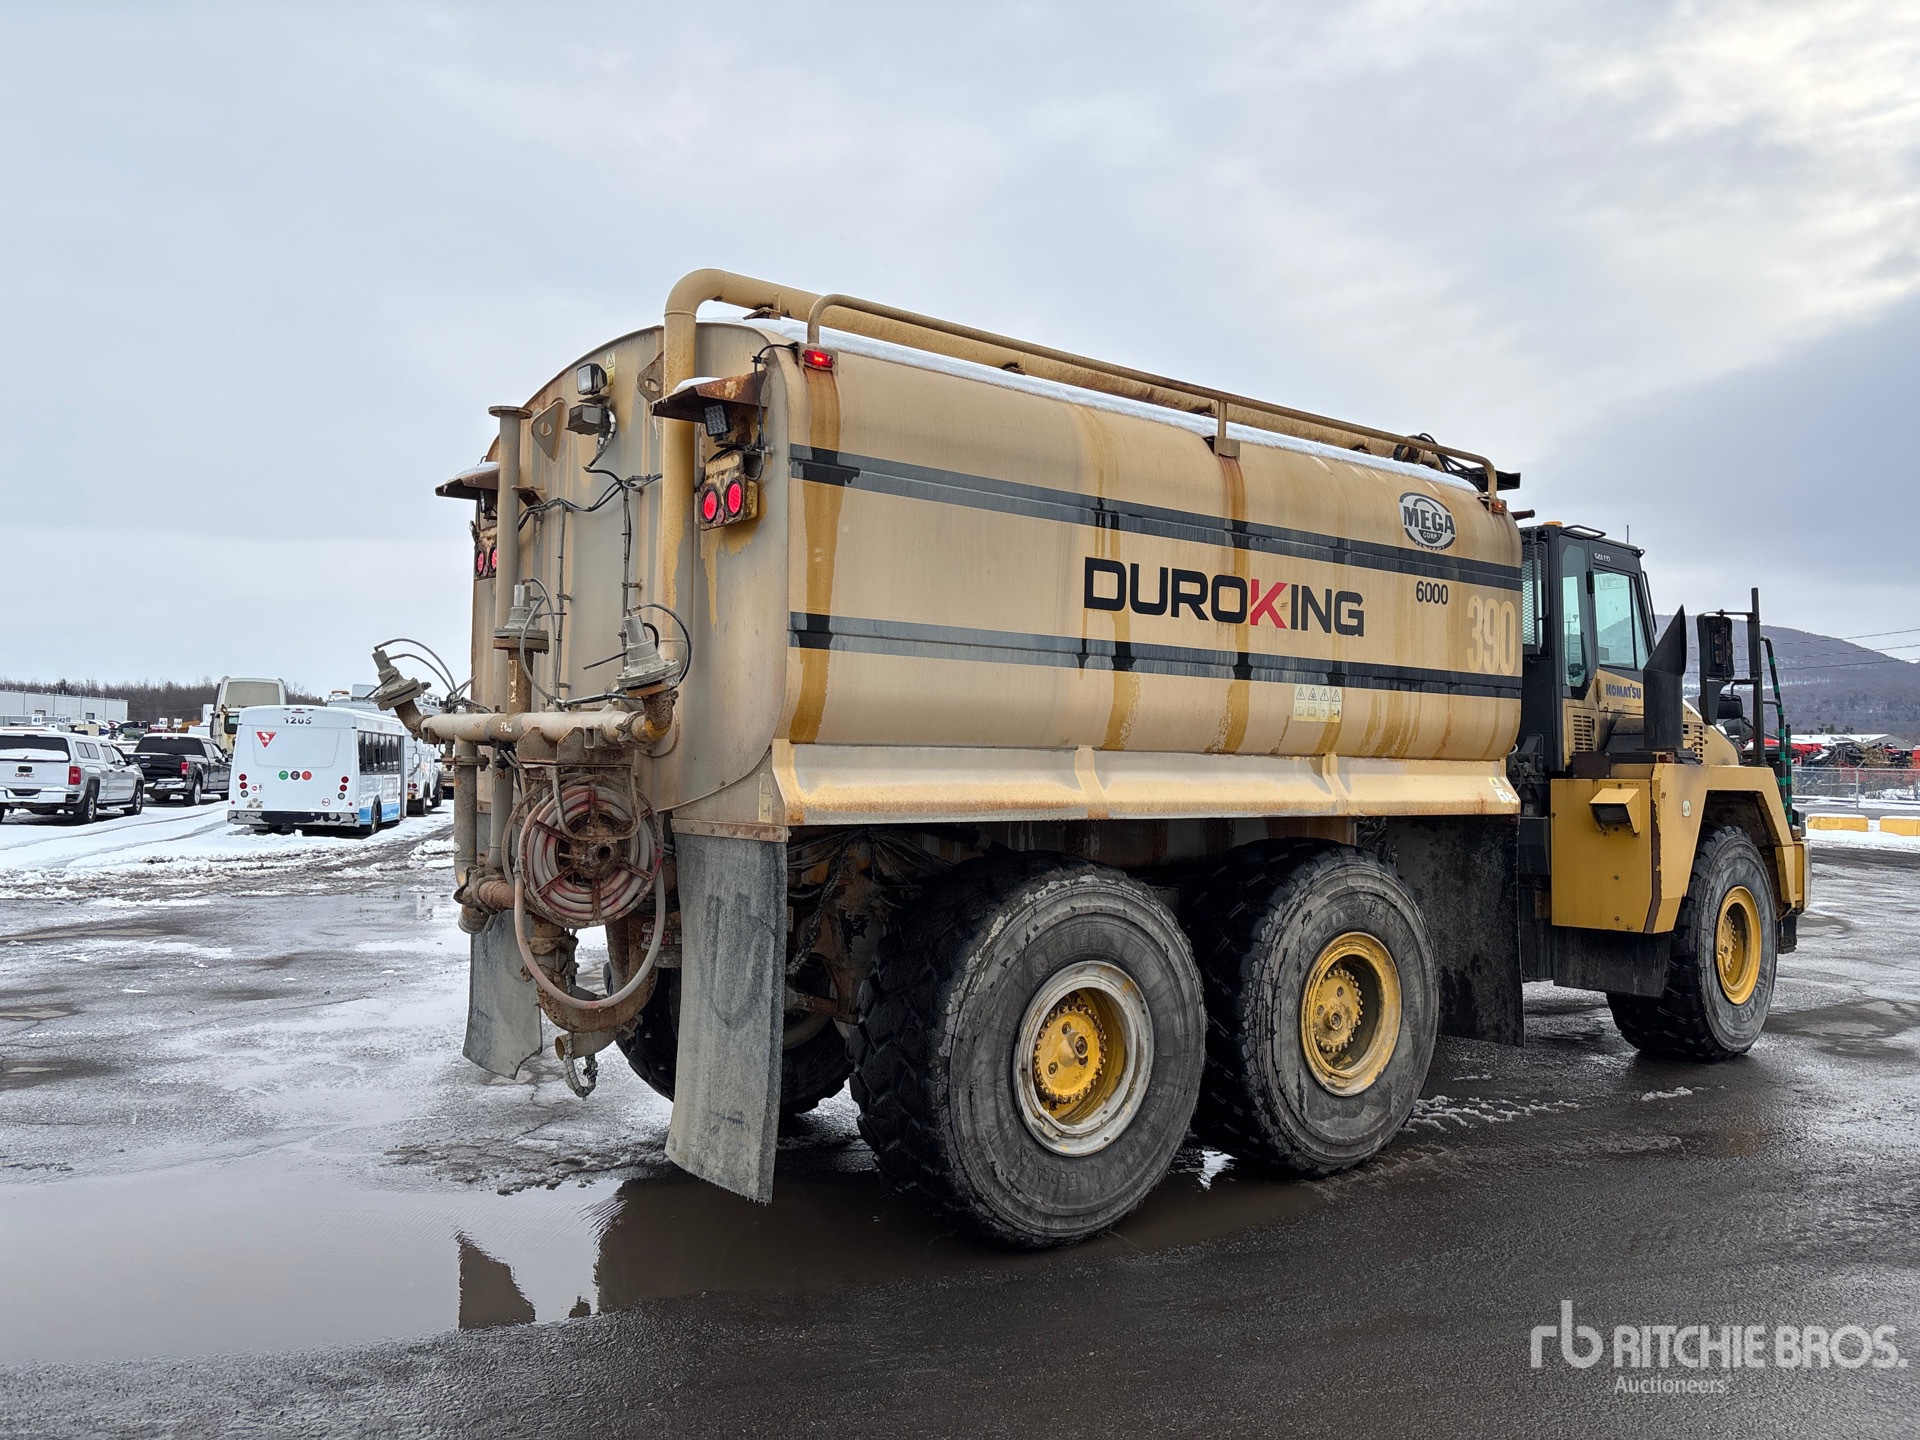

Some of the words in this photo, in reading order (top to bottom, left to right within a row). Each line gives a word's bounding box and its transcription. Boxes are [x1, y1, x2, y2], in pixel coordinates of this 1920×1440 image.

[1403, 505, 1456, 535] MEGA
[1084, 556, 1365, 637] DUROKING
[1416, 580, 1449, 605] 6000
[1466, 594, 1516, 675] 390
[1605, 683, 1642, 700] KOMATSU
